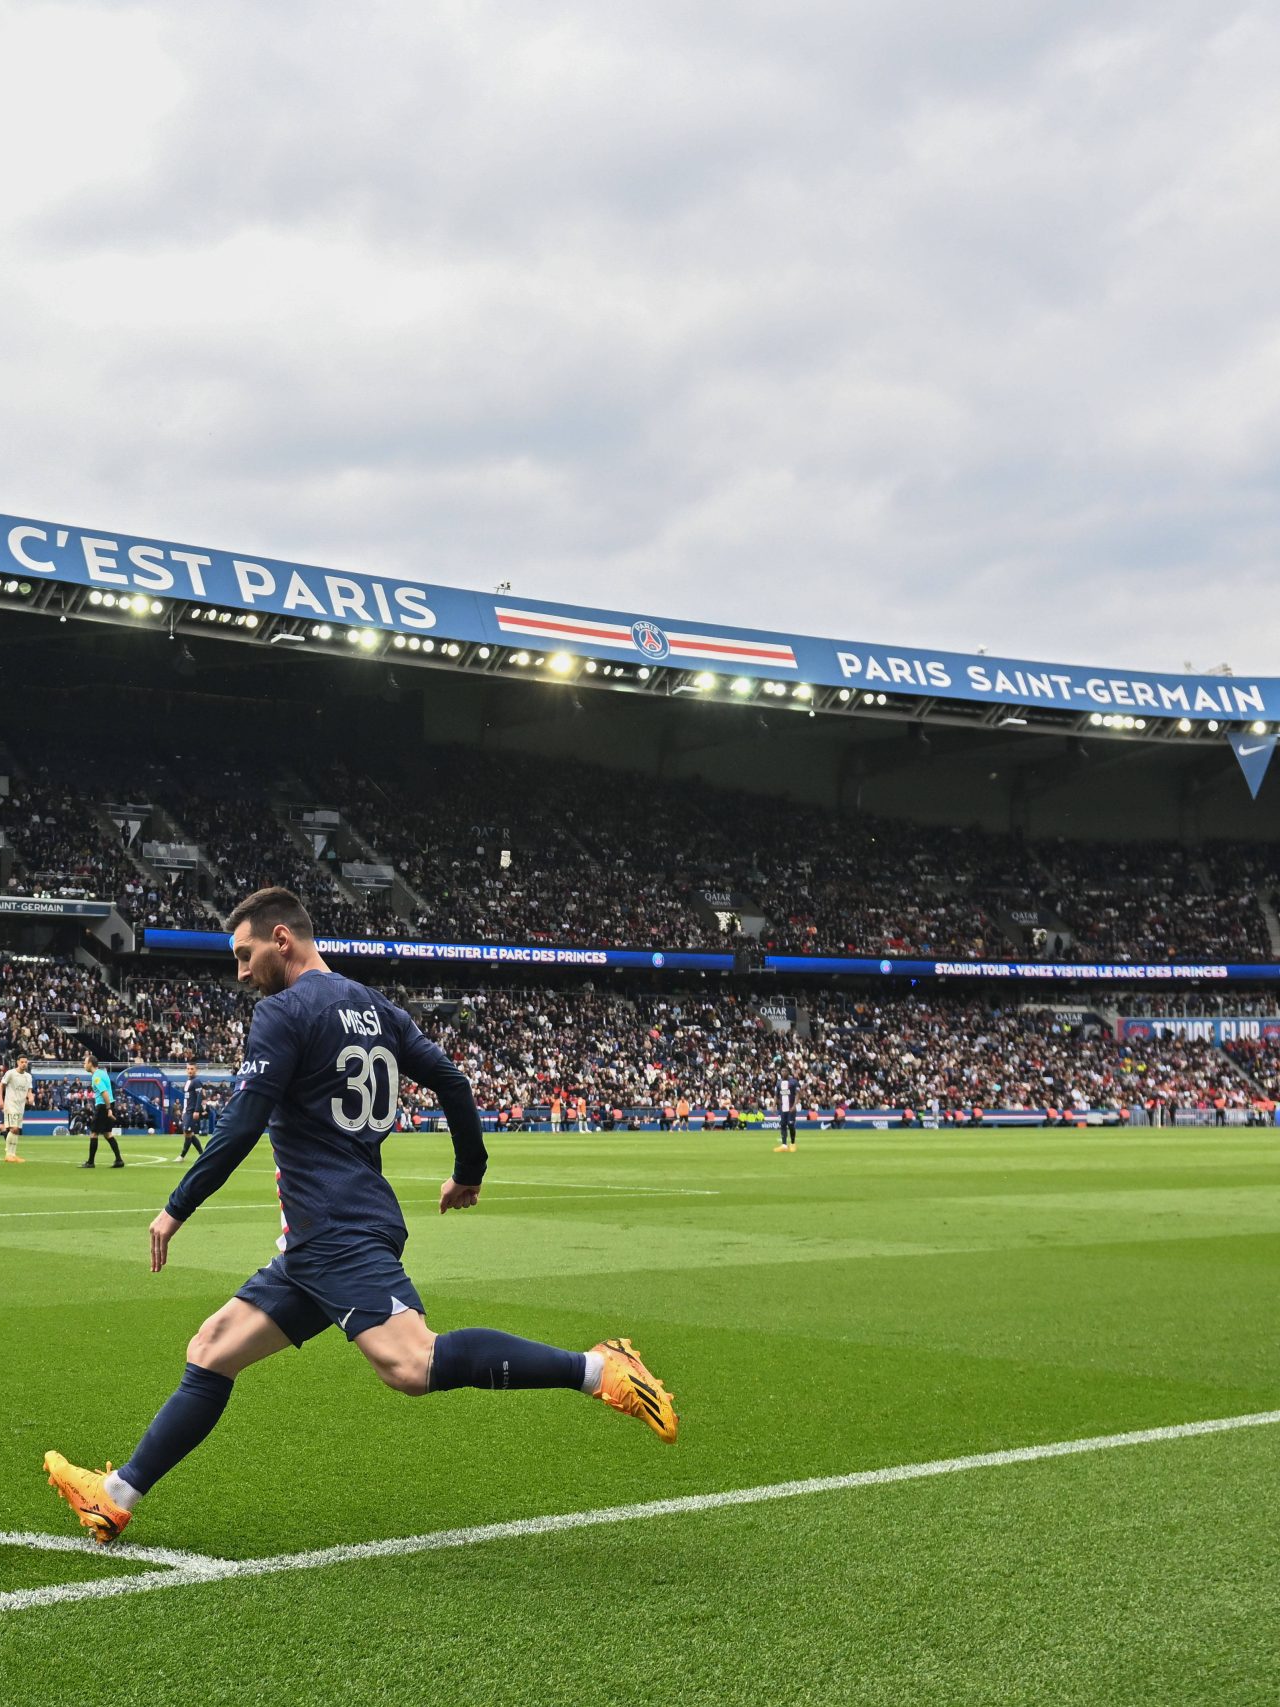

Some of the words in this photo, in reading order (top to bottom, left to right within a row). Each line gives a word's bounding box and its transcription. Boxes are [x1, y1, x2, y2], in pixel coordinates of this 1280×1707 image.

[7, 525, 212, 597] C'EST
[232, 560, 439, 629] PARIS
[836, 651, 952, 688] PARIS
[966, 665, 1266, 713] SAINT-GERMAIN
[314, 941, 351, 953] DIUM
[351, 942, 386, 955] TOUR
[394, 944, 435, 957] VENEZ
[436, 946, 483, 959] VISITER
[483, 948, 498, 960] LE
[499, 948, 531, 961] PARC
[532, 950, 556, 962] DES
[557, 951, 608, 964] PRINCES
[935, 963, 982, 975] STADIUM
[982, 964, 1010, 976] TOUR
[1016, 965, 1054, 977] VENEZ
[1055, 966, 1098, 978] VISITER
[1098, 966, 1113, 977] LE
[1113, 966, 1145, 978] PARC
[1146, 967, 1172, 978] DES
[1173, 967, 1228, 978] PRINCES
[760, 1006, 787, 1016] QATAR
[331, 1045, 399, 1132] 30
